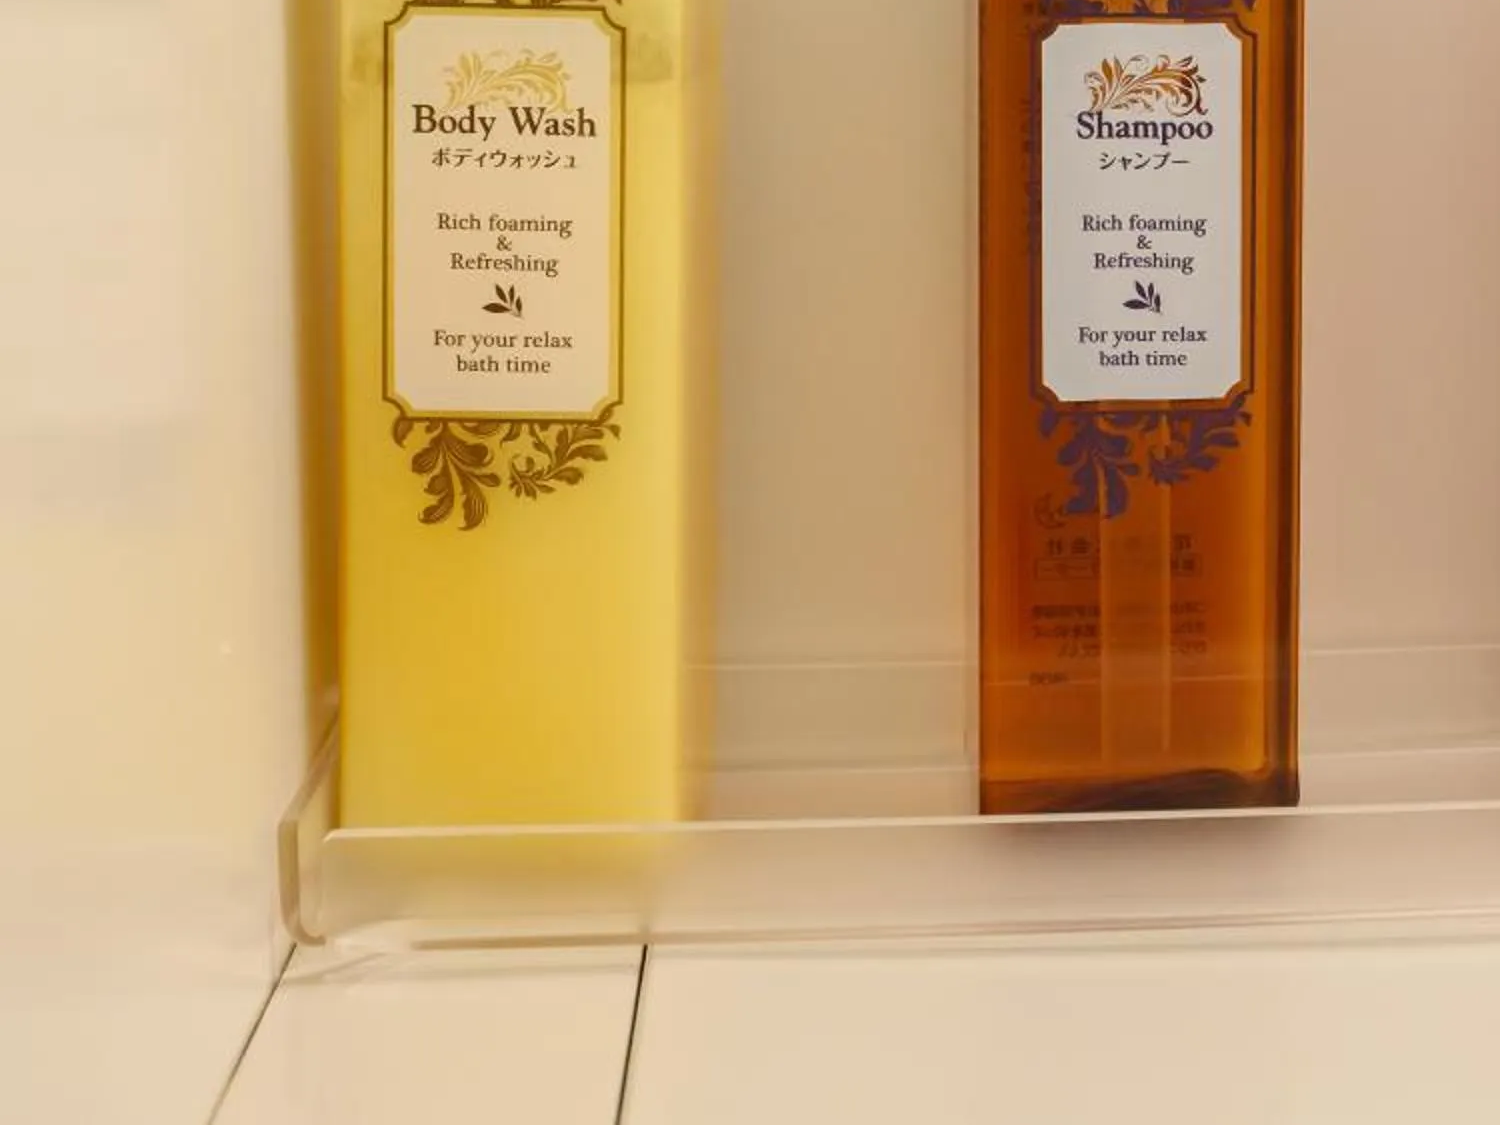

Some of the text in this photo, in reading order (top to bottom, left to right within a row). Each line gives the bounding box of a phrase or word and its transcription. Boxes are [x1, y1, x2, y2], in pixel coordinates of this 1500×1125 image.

[412, 104, 597, 142] Body Wash
[1076, 110, 1214, 146] Shampoo
[432, 147, 577, 169] ボディウォッシュ
[1099, 151, 1191, 171] シャンプー
[437, 213, 573, 238] Rich foaming
[1082, 215, 1207, 238] Rich foaming
[496, 236, 512, 252] &
[1136, 235, 1152, 250] &
[450, 252, 559, 278] Refreshing
[1094, 253, 1194, 275] Refreshing
[433, 330, 573, 354] For your relax
[1078, 326, 1207, 349] For your relax
[456, 354, 551, 374] bath time
[1099, 351, 1188, 367] bath time
